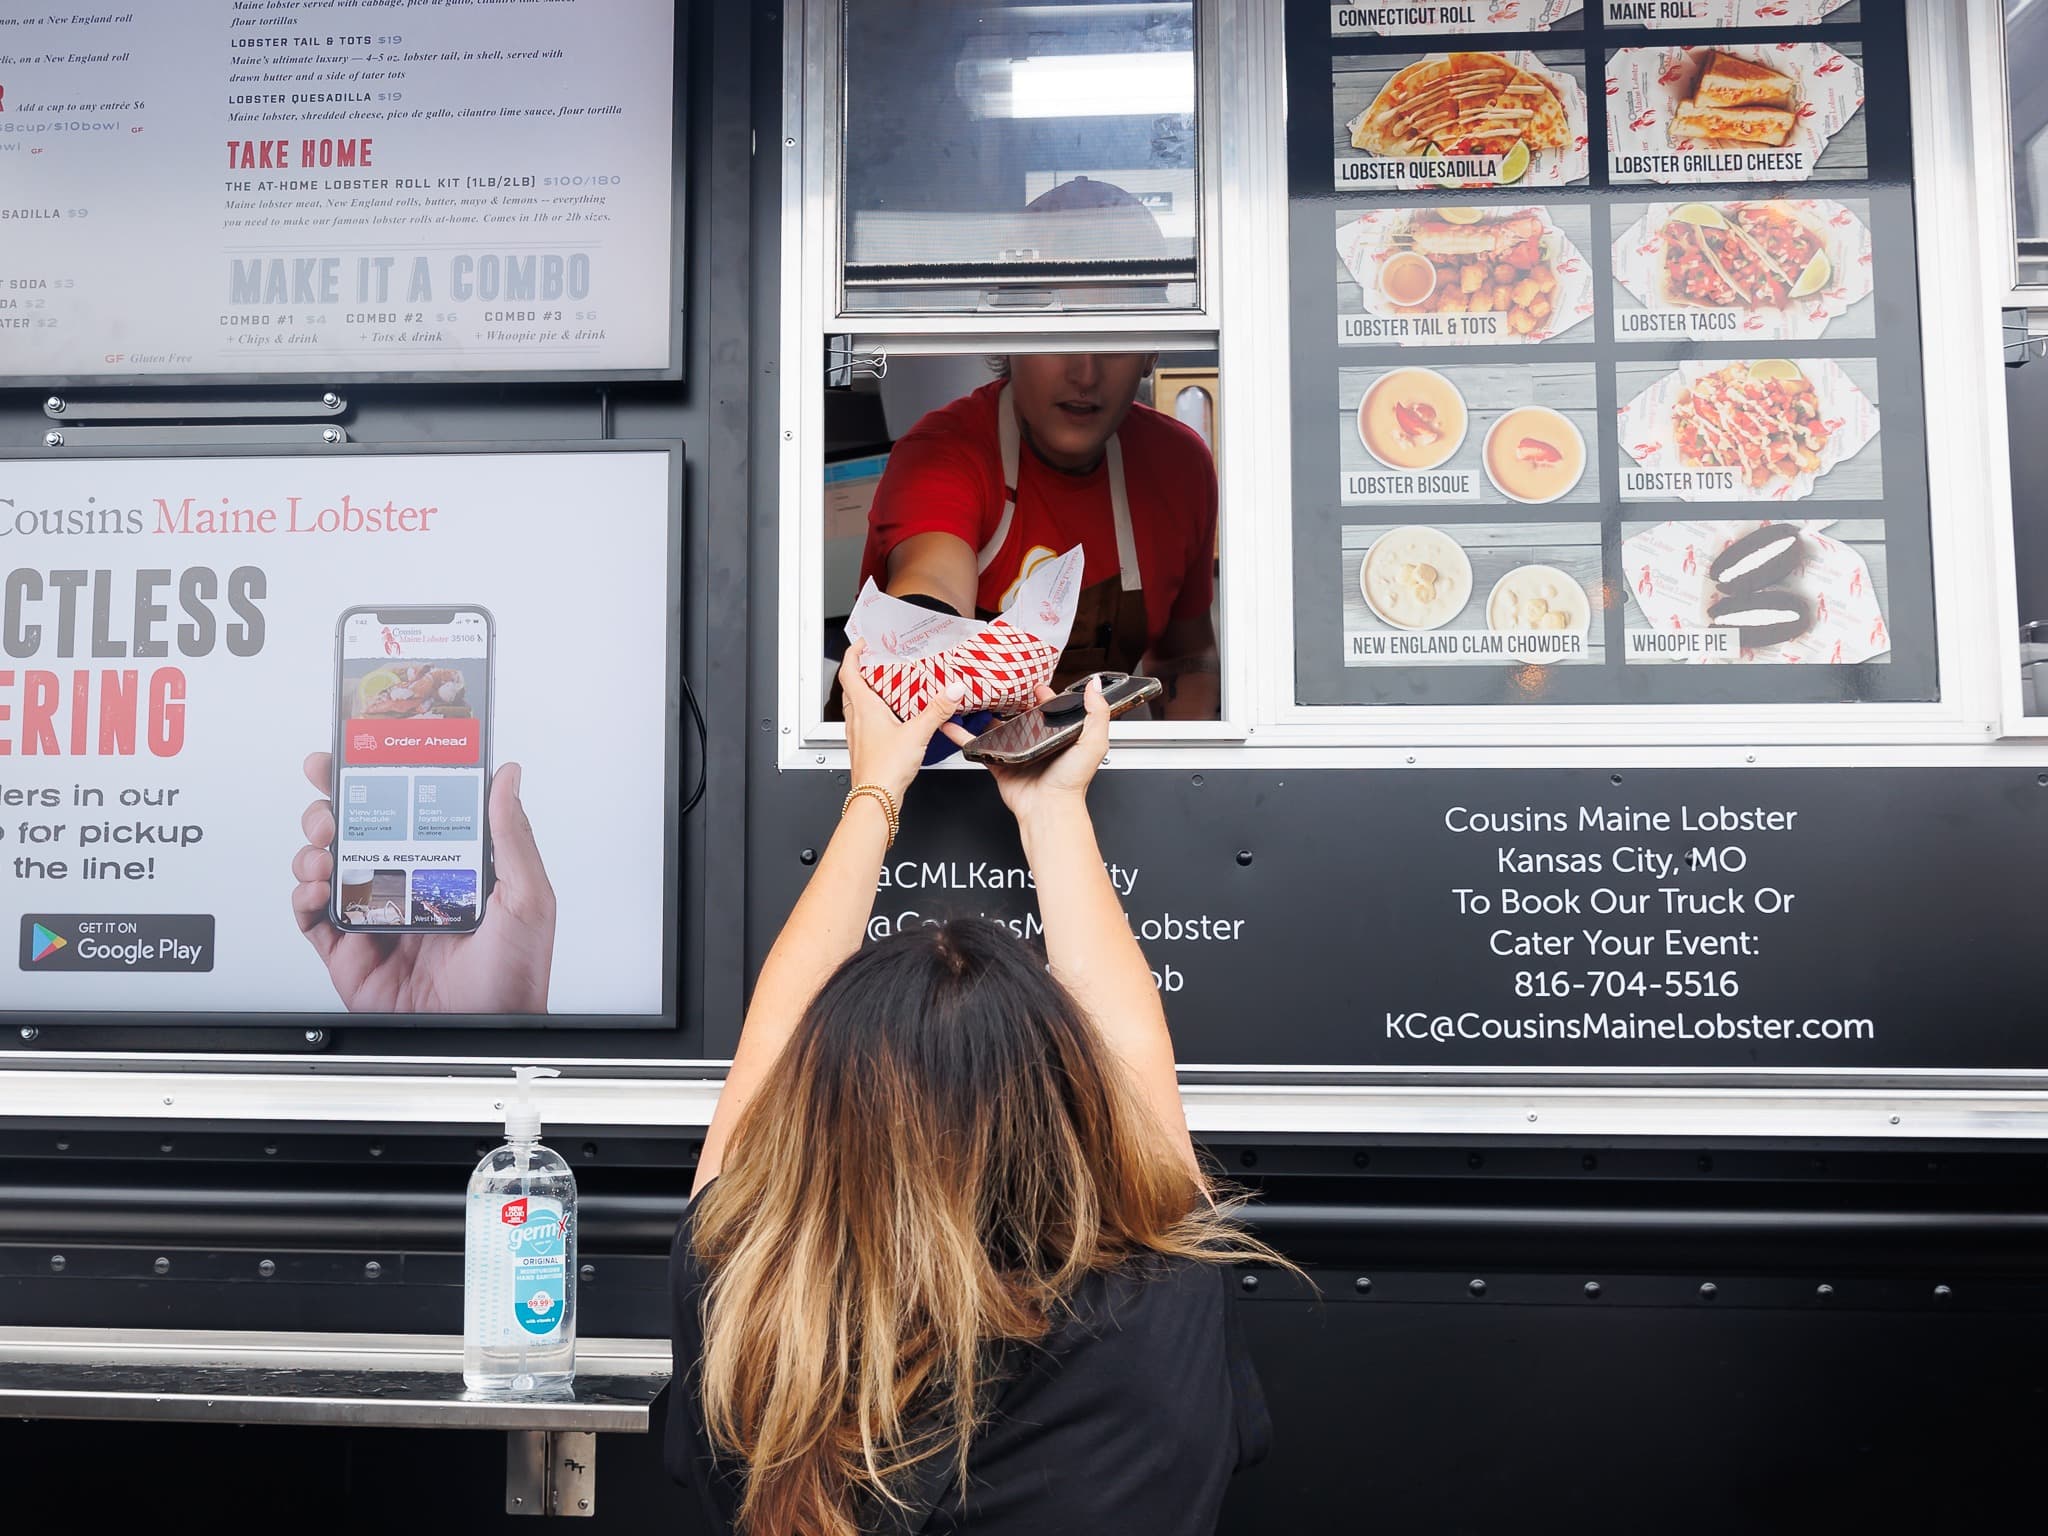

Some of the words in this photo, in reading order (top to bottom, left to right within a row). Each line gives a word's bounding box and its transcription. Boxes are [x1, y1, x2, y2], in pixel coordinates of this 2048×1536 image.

[233, 0, 263, 9] Maine
[267, 0, 300, 8] lobster
[303, 0, 334, 8] served
[1610, 2, 1656, 20] MAINE
[1660, 1, 1696, 18] ROLL
[47, 16, 68, 24] New
[71, 15, 112, 25] England
[115, 14, 133, 22] roll
[230, 18, 256, 28] flour
[260, 17, 297, 25] tortillas
[1339, 8, 1436, 26] CONNECTICUT
[1440, 6, 1475, 23] ROLL
[232, 38, 287, 47] LOBSTER
[294, 37, 320, 46] TAIL
[327, 37, 333, 45] &
[339, 36, 371, 45] TOTS
[378, 36, 402, 44] $19
[231, 56, 269, 64] Maine's
[273, 56, 313, 64] ultimate
[316, 55, 348, 64] luxury
[404, 53, 438, 61] lobster
[441, 52, 459, 60] tail,
[477, 51, 503, 59] shell,
[507, 50, 539, 58] served
[542, 50, 562, 58] with
[230, 74, 259, 82] drawn
[263, 73, 293, 81] butter
[296, 72, 314, 80] and
[326, 72, 345, 80] side
[349, 72, 360, 81] of
[47, 105, 64, 113] cup
[80, 104, 97, 112] any
[134, 101, 144, 109] $6
[229, 95, 285, 104] LOBSTER
[292, 93, 371, 104] QUESADILLA
[379, 93, 402, 101] $19
[228, 112, 259, 121] Maine
[262, 112, 297, 120] lobster,
[301, 111, 346, 120] shredded
[349, 111, 383, 119] cheese,
[387, 110, 408, 120] pico
[425, 109, 453, 119] gallo,
[457, 109, 496, 117] cilantro
[500, 108, 521, 116] lime
[524, 108, 555, 116] sauce,
[557, 107, 584, 117] flour
[588, 106, 622, 114] tortilla
[227, 140, 289, 169] TAKE
[302, 139, 372, 168] HOME
[1616, 156, 1679, 173] LOBSTER
[1684, 154, 1742, 172] GRILLED
[1747, 153, 1803, 170] CHEESE
[1343, 162, 1405, 180] LOBSTER
[1409, 160, 1496, 179] QUESADILLA
[225, 182, 251, 191] THE
[258, 180, 320, 191] AT-HOME
[325, 179, 389, 190] LOBSTER
[396, 177, 431, 188] ROLL
[438, 179, 460, 188] KIT
[544, 176, 620, 185] $100/180
[259, 200, 293, 208] lobster
[326, 199, 348, 207] New
[351, 198, 393, 208] England
[396, 198, 421, 206] rolls,
[425, 197, 456, 207] butter,
[461, 199, 487, 207] mayo
[490, 196, 498, 205] &
[503, 196, 537, 204] lemons
[553, 195, 606, 205] everything
[229, 255, 340, 305] MAKE
[352, 256, 395, 304] IT
[406, 257, 432, 303] A
[450, 253, 590, 302] COMBO
[1346, 319, 1408, 336] LOBSTER
[1412, 318, 1443, 335] TAIL
[1448, 318, 1456, 335] &
[1460, 315, 1496, 334] TOTS
[1622, 314, 1686, 331] LOBSTER
[1690, 313, 1736, 330] TACOS
[1350, 476, 1413, 494] LOBSTER
[1418, 476, 1469, 493] BISQUE
[1627, 472, 1692, 490] LOBSTER
[1696, 472, 1732, 489] TOTS
[152, 496, 276, 536] Maine
[285, 495, 438, 535] Lobster
[3, 566, 267, 658] CTLESS
[1353, 637, 1385, 654] NEW
[1391, 636, 1457, 654] ENGLAND
[1463, 636, 1503, 653] CLAM
[1508, 635, 1580, 653] CHOWDER
[1632, 634, 1700, 652] WHOOPIE
[1705, 634, 1727, 651] PIE
[385, 737, 421, 746] Order
[424, 737, 467, 745] Ahead
[0, 785, 60, 807] ers
[74, 784, 103, 806] in
[120, 789, 179, 806] our
[1445, 807, 1567, 832] Cousins
[1579, 806, 1670, 831] Maine
[1682, 806, 1797, 831] Lobster
[18, 822, 66, 843] for
[80, 822, 203, 847] pickup
[13, 857, 68, 879] the
[83, 857, 154, 880] line!
[1499, 848, 1602, 873] Kansas
[1613, 847, 1678, 879] City,
[1691, 846, 1747, 873] MO
[1452, 889, 1490, 914] To
[1502, 889, 1581, 914] Book
[1591, 888, 1650, 913] Our
[1658, 888, 1745, 914] Truck
[1755, 888, 1795, 913] Or
[79, 922, 103, 933] GET
[106, 923, 115, 933] IT
[118, 923, 136, 933] ON
[78, 938, 154, 964] Google
[159, 939, 202, 964] Play
[1490, 930, 1574, 955] Cater
[1583, 930, 1655, 955] Your
[1666, 930, 1759, 955] Event:
[1515, 971, 1738, 997] 816-704-5516
[1387, 1013, 1874, 1042] KC@CousinsMaineLobster.com
[523, 1257, 559, 1266] ORIGINAL
